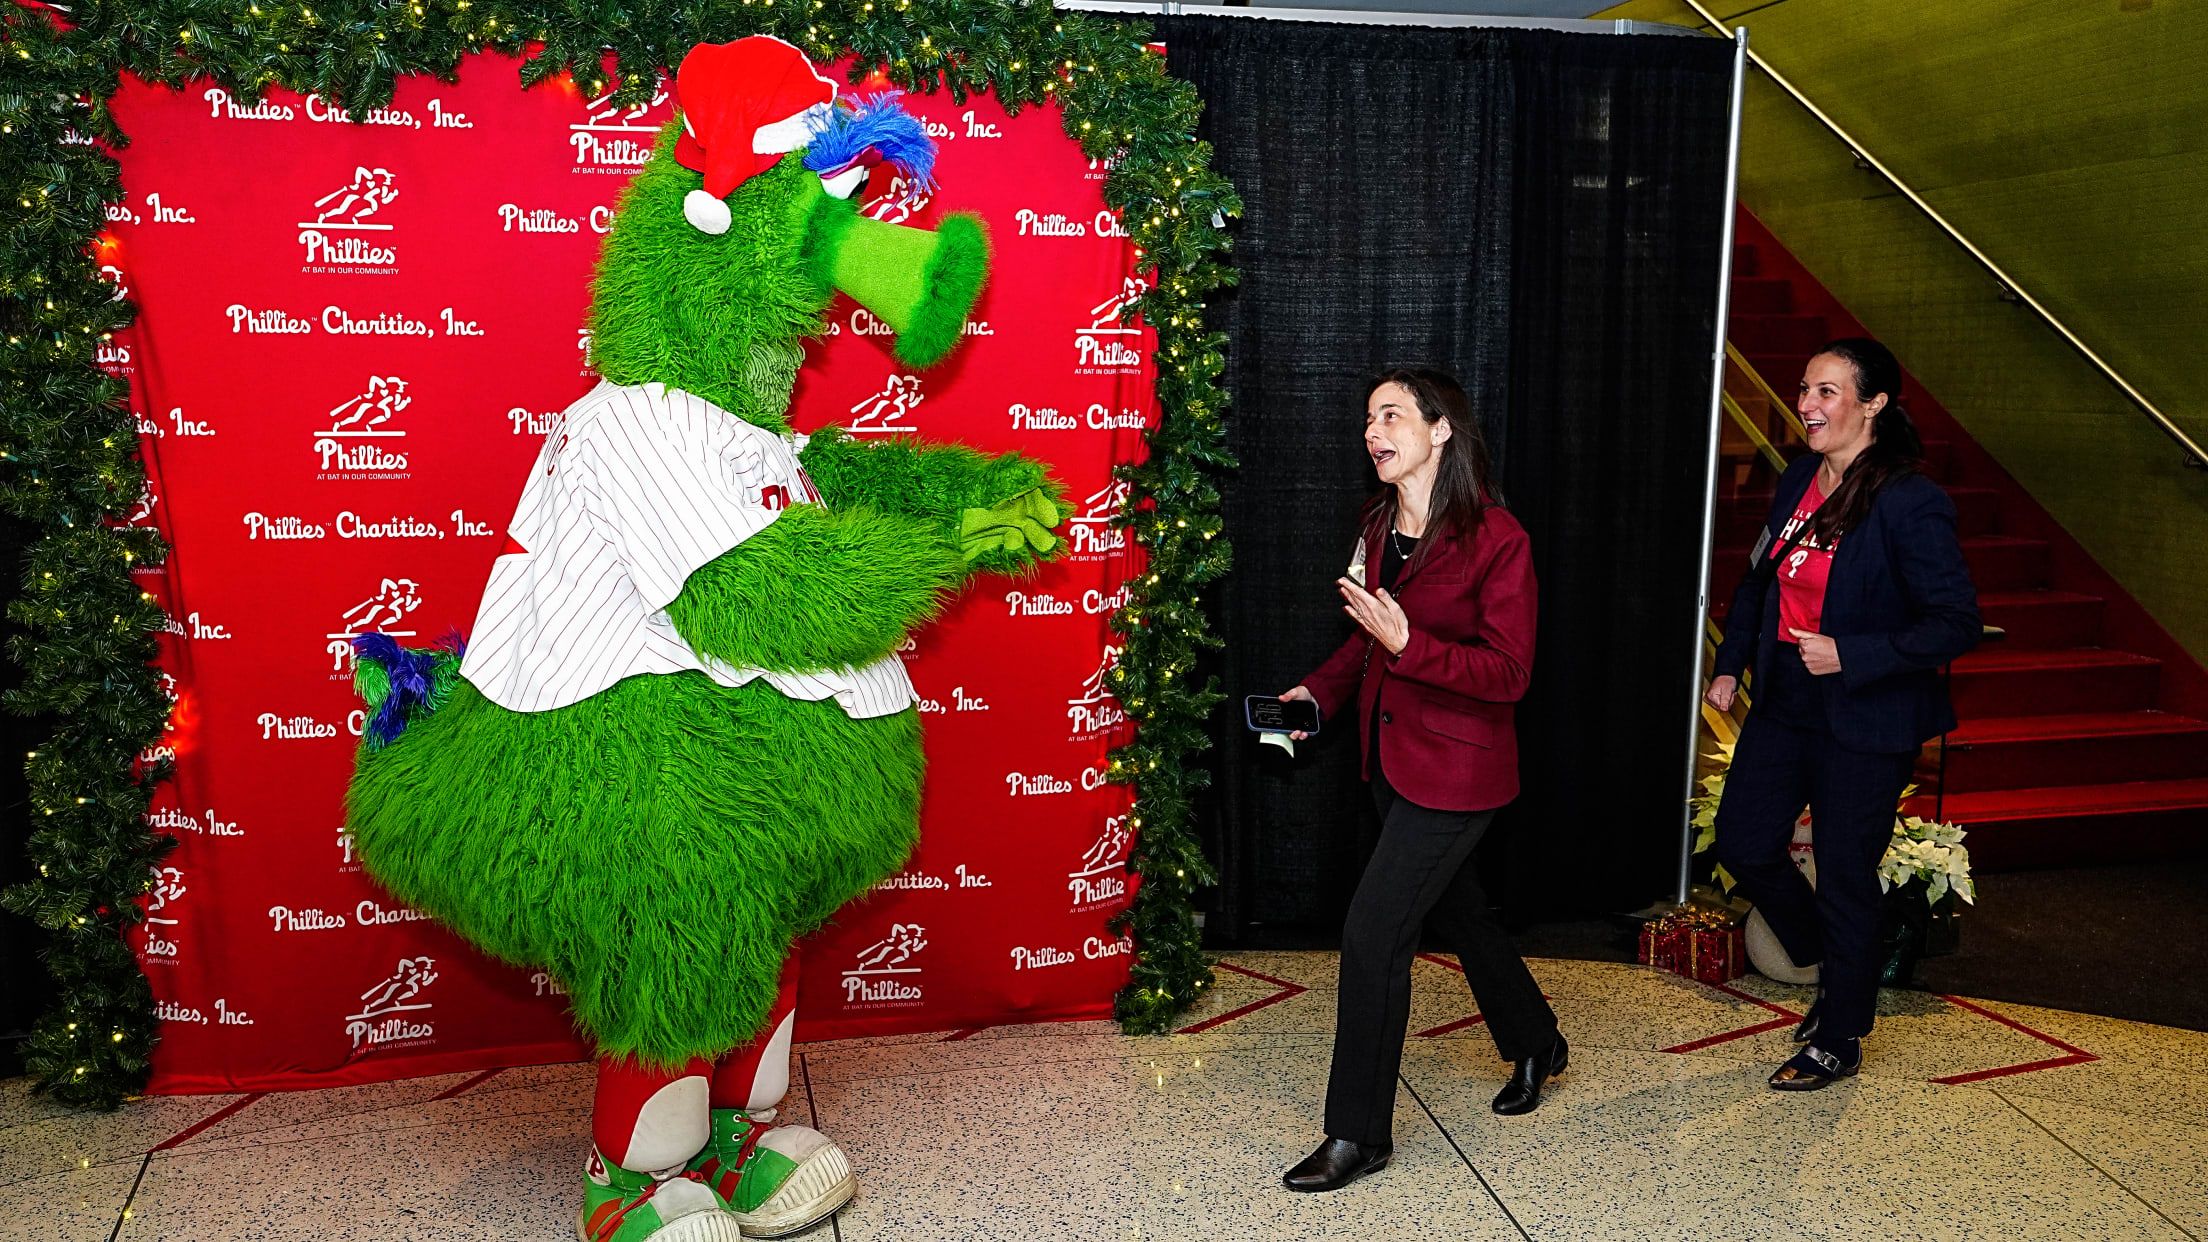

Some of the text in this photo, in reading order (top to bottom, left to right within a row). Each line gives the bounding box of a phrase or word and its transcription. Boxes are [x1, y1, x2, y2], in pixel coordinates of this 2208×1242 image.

[428, 99, 473, 129] Inc.
[962, 110, 1002, 138] Inc.
[570, 131, 654, 165] Phillie
[146, 193, 195, 223] Inc.
[337, 267, 353, 275] OUR
[355, 267, 399, 275] COMMUNITY
[322, 305, 434, 338] Charities,
[440, 307, 485, 336] Inc.
[169, 407, 216, 436] Inc.
[507, 407, 560, 435] Phill
[336, 511, 445, 540] Charities,
[450, 509, 494, 537] Inc.
[1789, 550, 1808, 579] P
[188, 612, 232, 639] Inc.
[952, 686, 990, 711] Inc.
[142, 806, 245, 836] rities, Inc.
[955, 864, 992, 888] Inc.
[1068, 877, 1124, 905] Phillie
[214, 998, 254, 1025] Inc.
[589, 1150, 605, 1179] P
